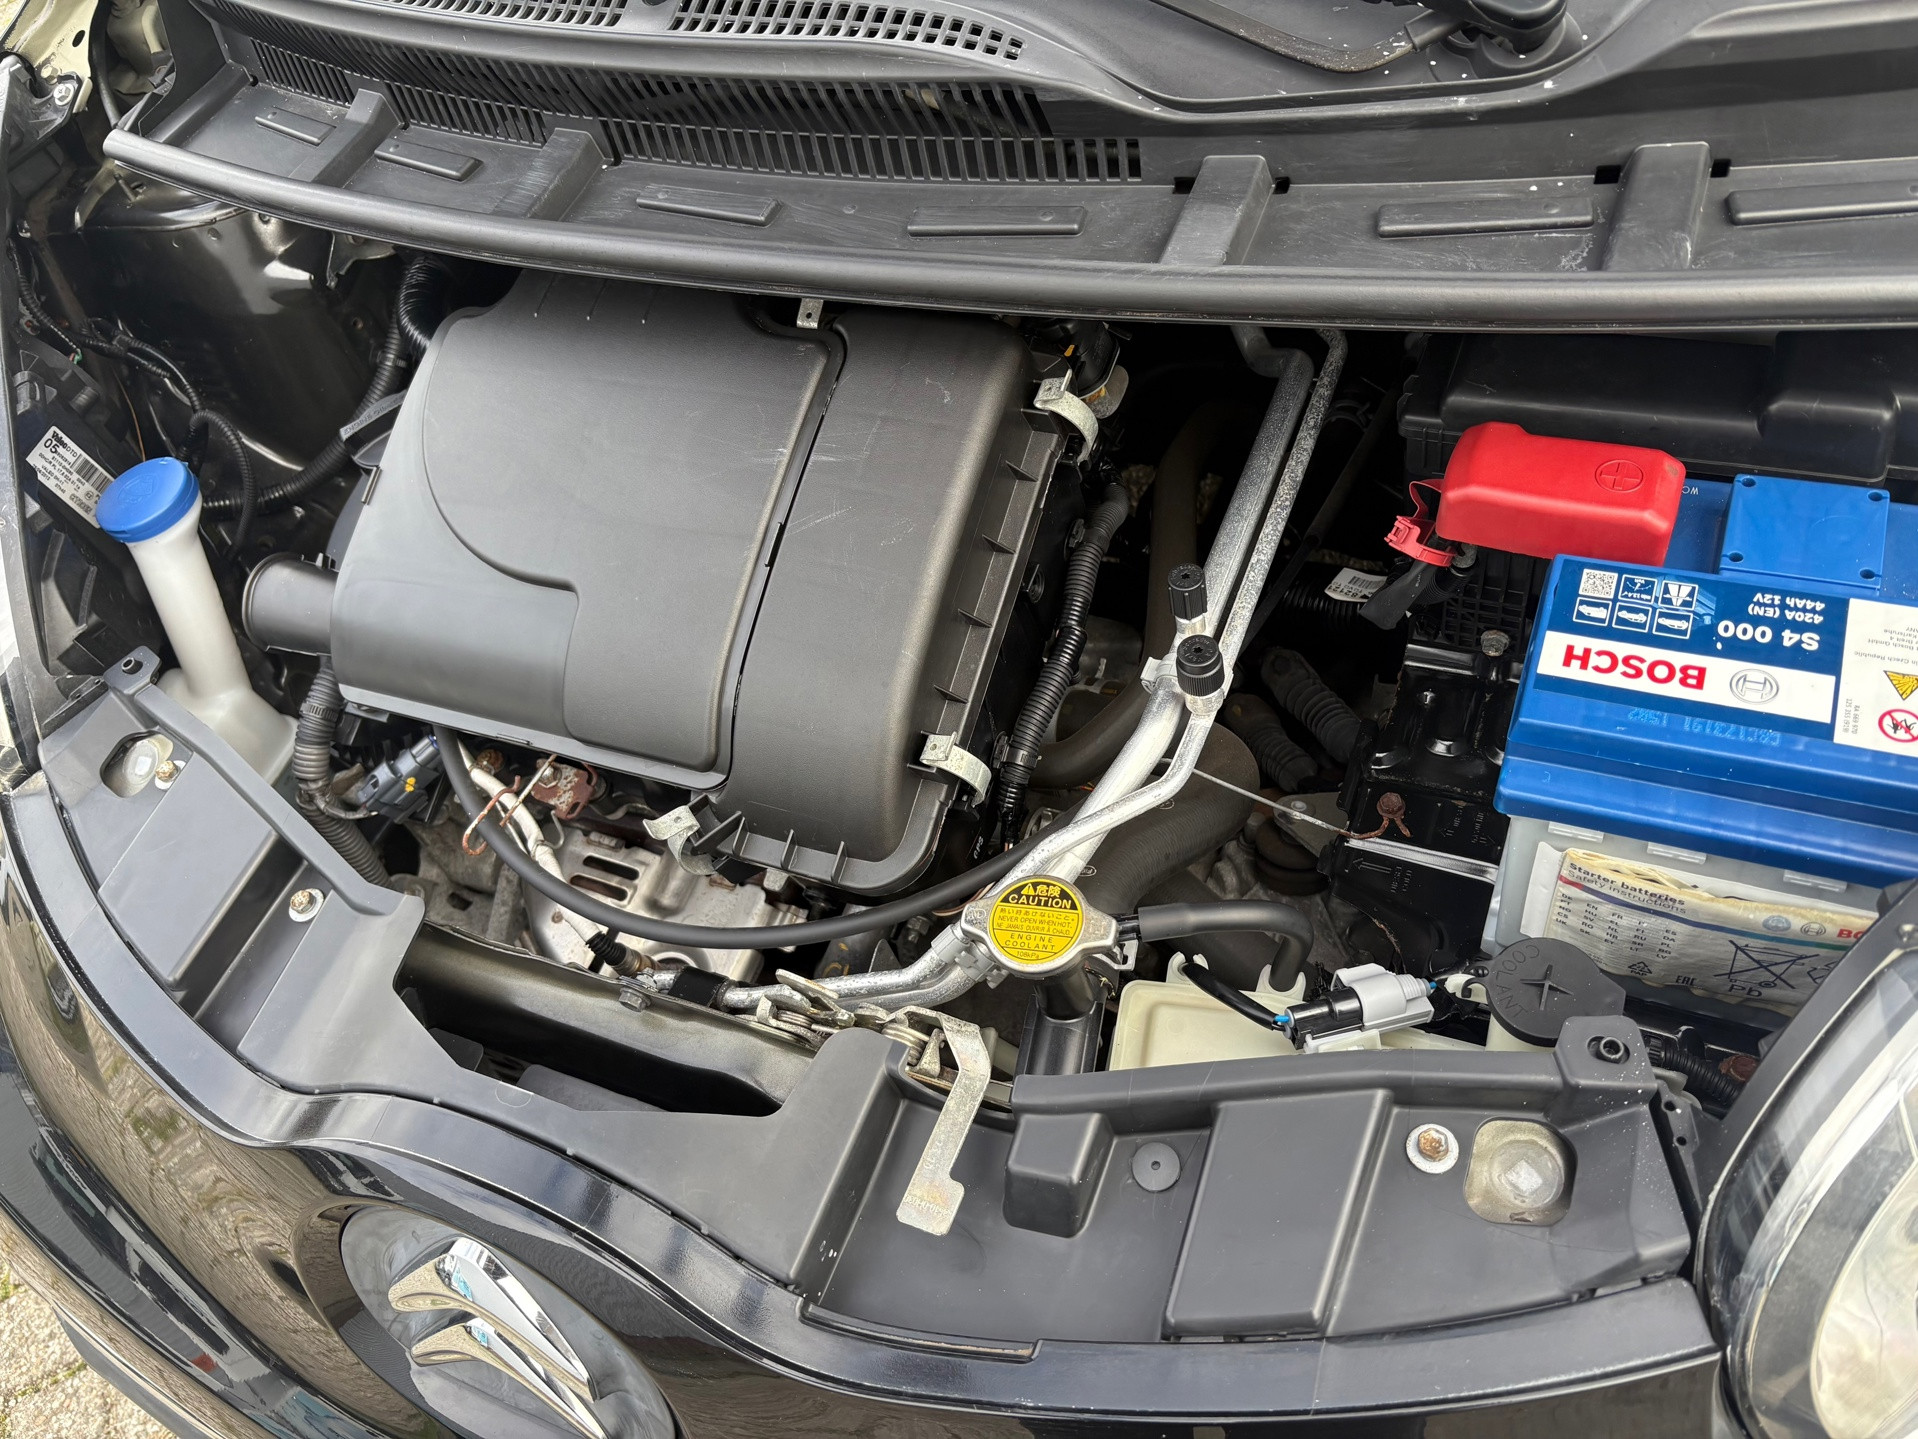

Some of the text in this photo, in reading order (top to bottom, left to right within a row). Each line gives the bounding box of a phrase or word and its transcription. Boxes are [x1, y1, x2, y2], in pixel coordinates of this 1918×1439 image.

[44, 438, 60, 454] 05
[1753, 592, 1826, 612] 44Ah 12V
[1748, 604, 1824, 624] 420A (EN)
[1717, 620, 1821, 651] S4 000
[1854, 650, 1886, 660] Republic
[1562, 644, 1707, 690] BOSCH
[1036, 884, 1062, 898] 危険
[1570, 862, 1686, 906] Starter batteries
[1568, 870, 1686, 914] Safety instructions
[1008, 894, 1072, 909] CAUTION
[1584, 909, 1598, 917] HU
[998, 914, 1018, 922] NEVER
[1020, 916, 1037, 924] OPEN
[1038, 919, 1057, 927] WHEN
[1556, 918, 1568, 926] UK
[1026, 925, 1046, 933] OUVRIR
[1582, 921, 1594, 930] RO
[1606, 932, 1618, 940] HR
[1608, 926, 1619, 934] NL
[1010, 932, 1053, 943] ENGINE
[1004, 940, 1056, 950] COOLANT
[1016, 950, 1040, 960] 108kPa
[1494, 944, 1540, 1018] COOLANT
[1728, 984, 1762, 998] Pb
